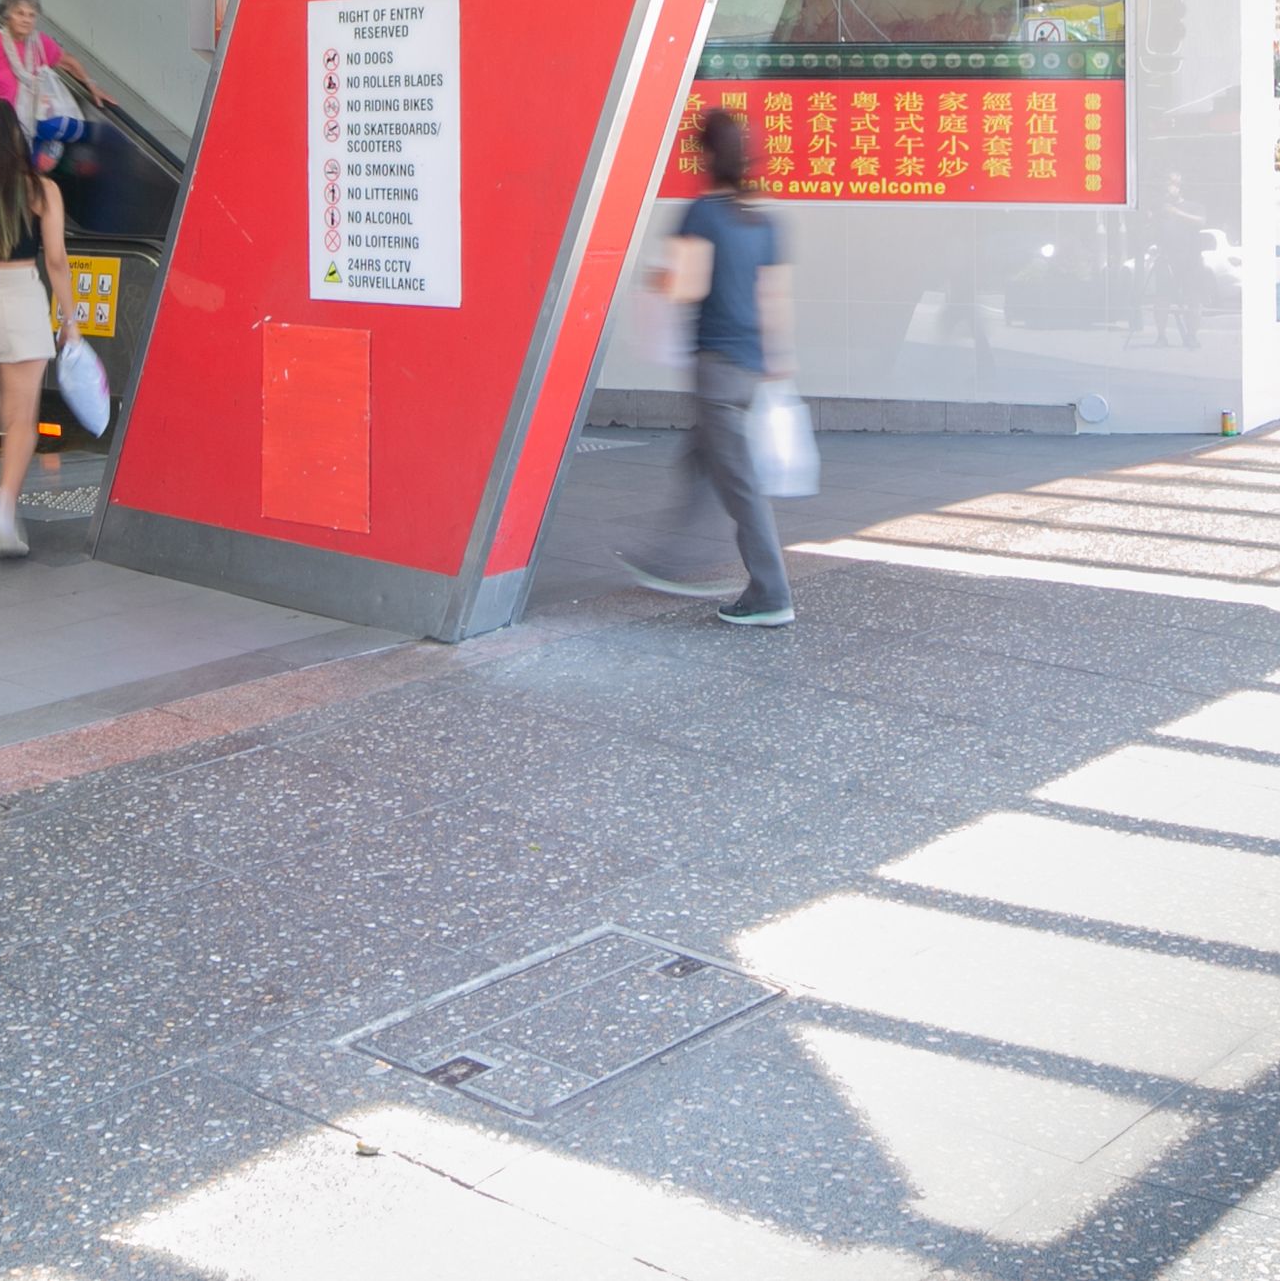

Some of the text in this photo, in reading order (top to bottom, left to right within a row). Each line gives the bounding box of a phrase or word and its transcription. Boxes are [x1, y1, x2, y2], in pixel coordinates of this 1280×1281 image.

[338, 7, 424, 23] RIGHT OF ENTRY
[354, 25, 409, 39] RESERVED
[346, 51, 393, 65] NO DOGS
[346, 73, 444, 88] NO ROLLER BLADES
[347, 98, 434, 112] NO RIDING BIKES
[347, 122, 441, 136] NO SKATEBOARDS/
[894, 91, 925, 178] 港式午茶
[347, 140, 402, 153] SCOOTERS
[347, 164, 415, 177] NO SMOKING
[347, 187, 419, 201] NO LITTERING
[788, 179, 844, 197] away
[849, 177, 946, 194] welcome
[348, 211, 413, 225] NO ALCOHOL
[348, 235, 420, 250] NO LOITERING
[348, 258, 411, 273] 24HRS CCTV
[348, 274, 425, 291] SURVEILLANCE
